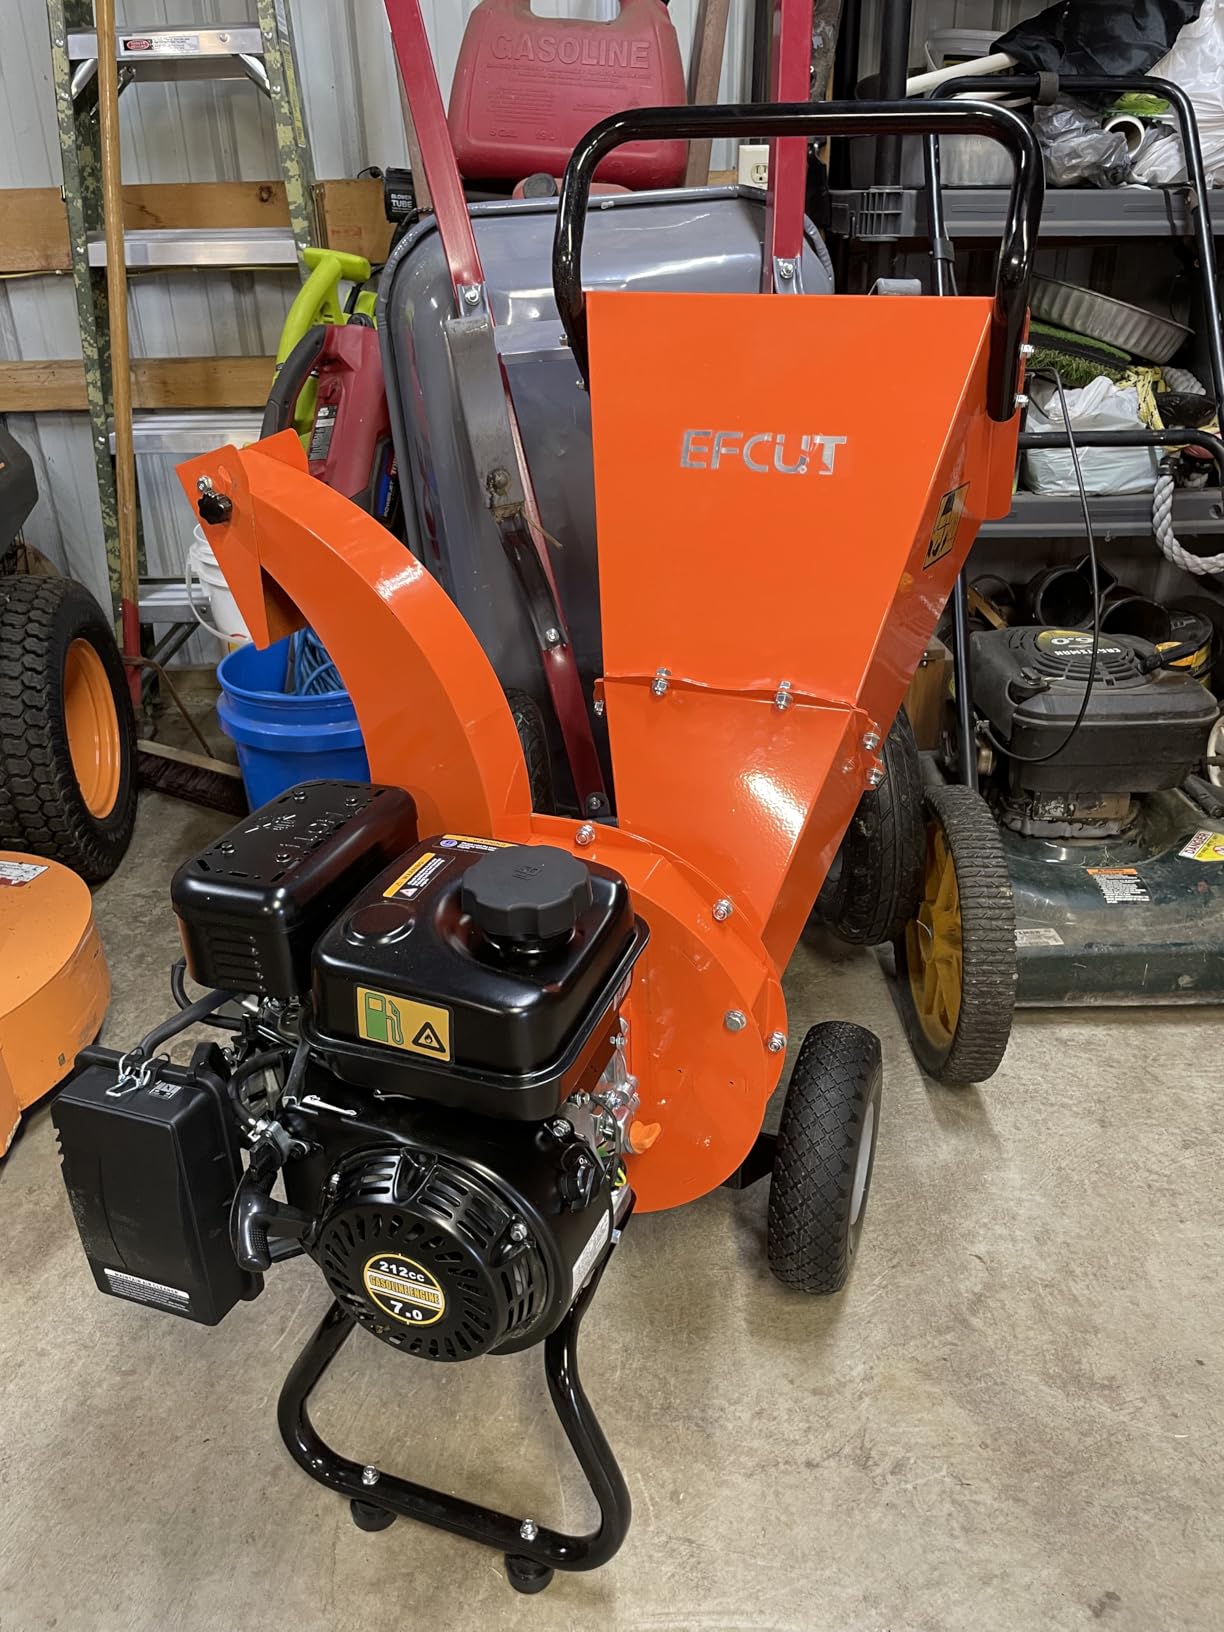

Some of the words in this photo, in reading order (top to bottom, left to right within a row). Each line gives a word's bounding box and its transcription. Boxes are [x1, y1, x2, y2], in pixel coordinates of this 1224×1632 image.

[491, 32, 650, 69] GASOLINE
[391, 199, 413, 208] TUBE
[680, 429, 848, 475] EFCUT
[379, 1261, 425, 1282] 212cc
[369, 1274, 409, 1297] GASOLINE
[408, 1286, 440, 1305] ENGINE
[390, 1300, 423, 1321] 7.0
